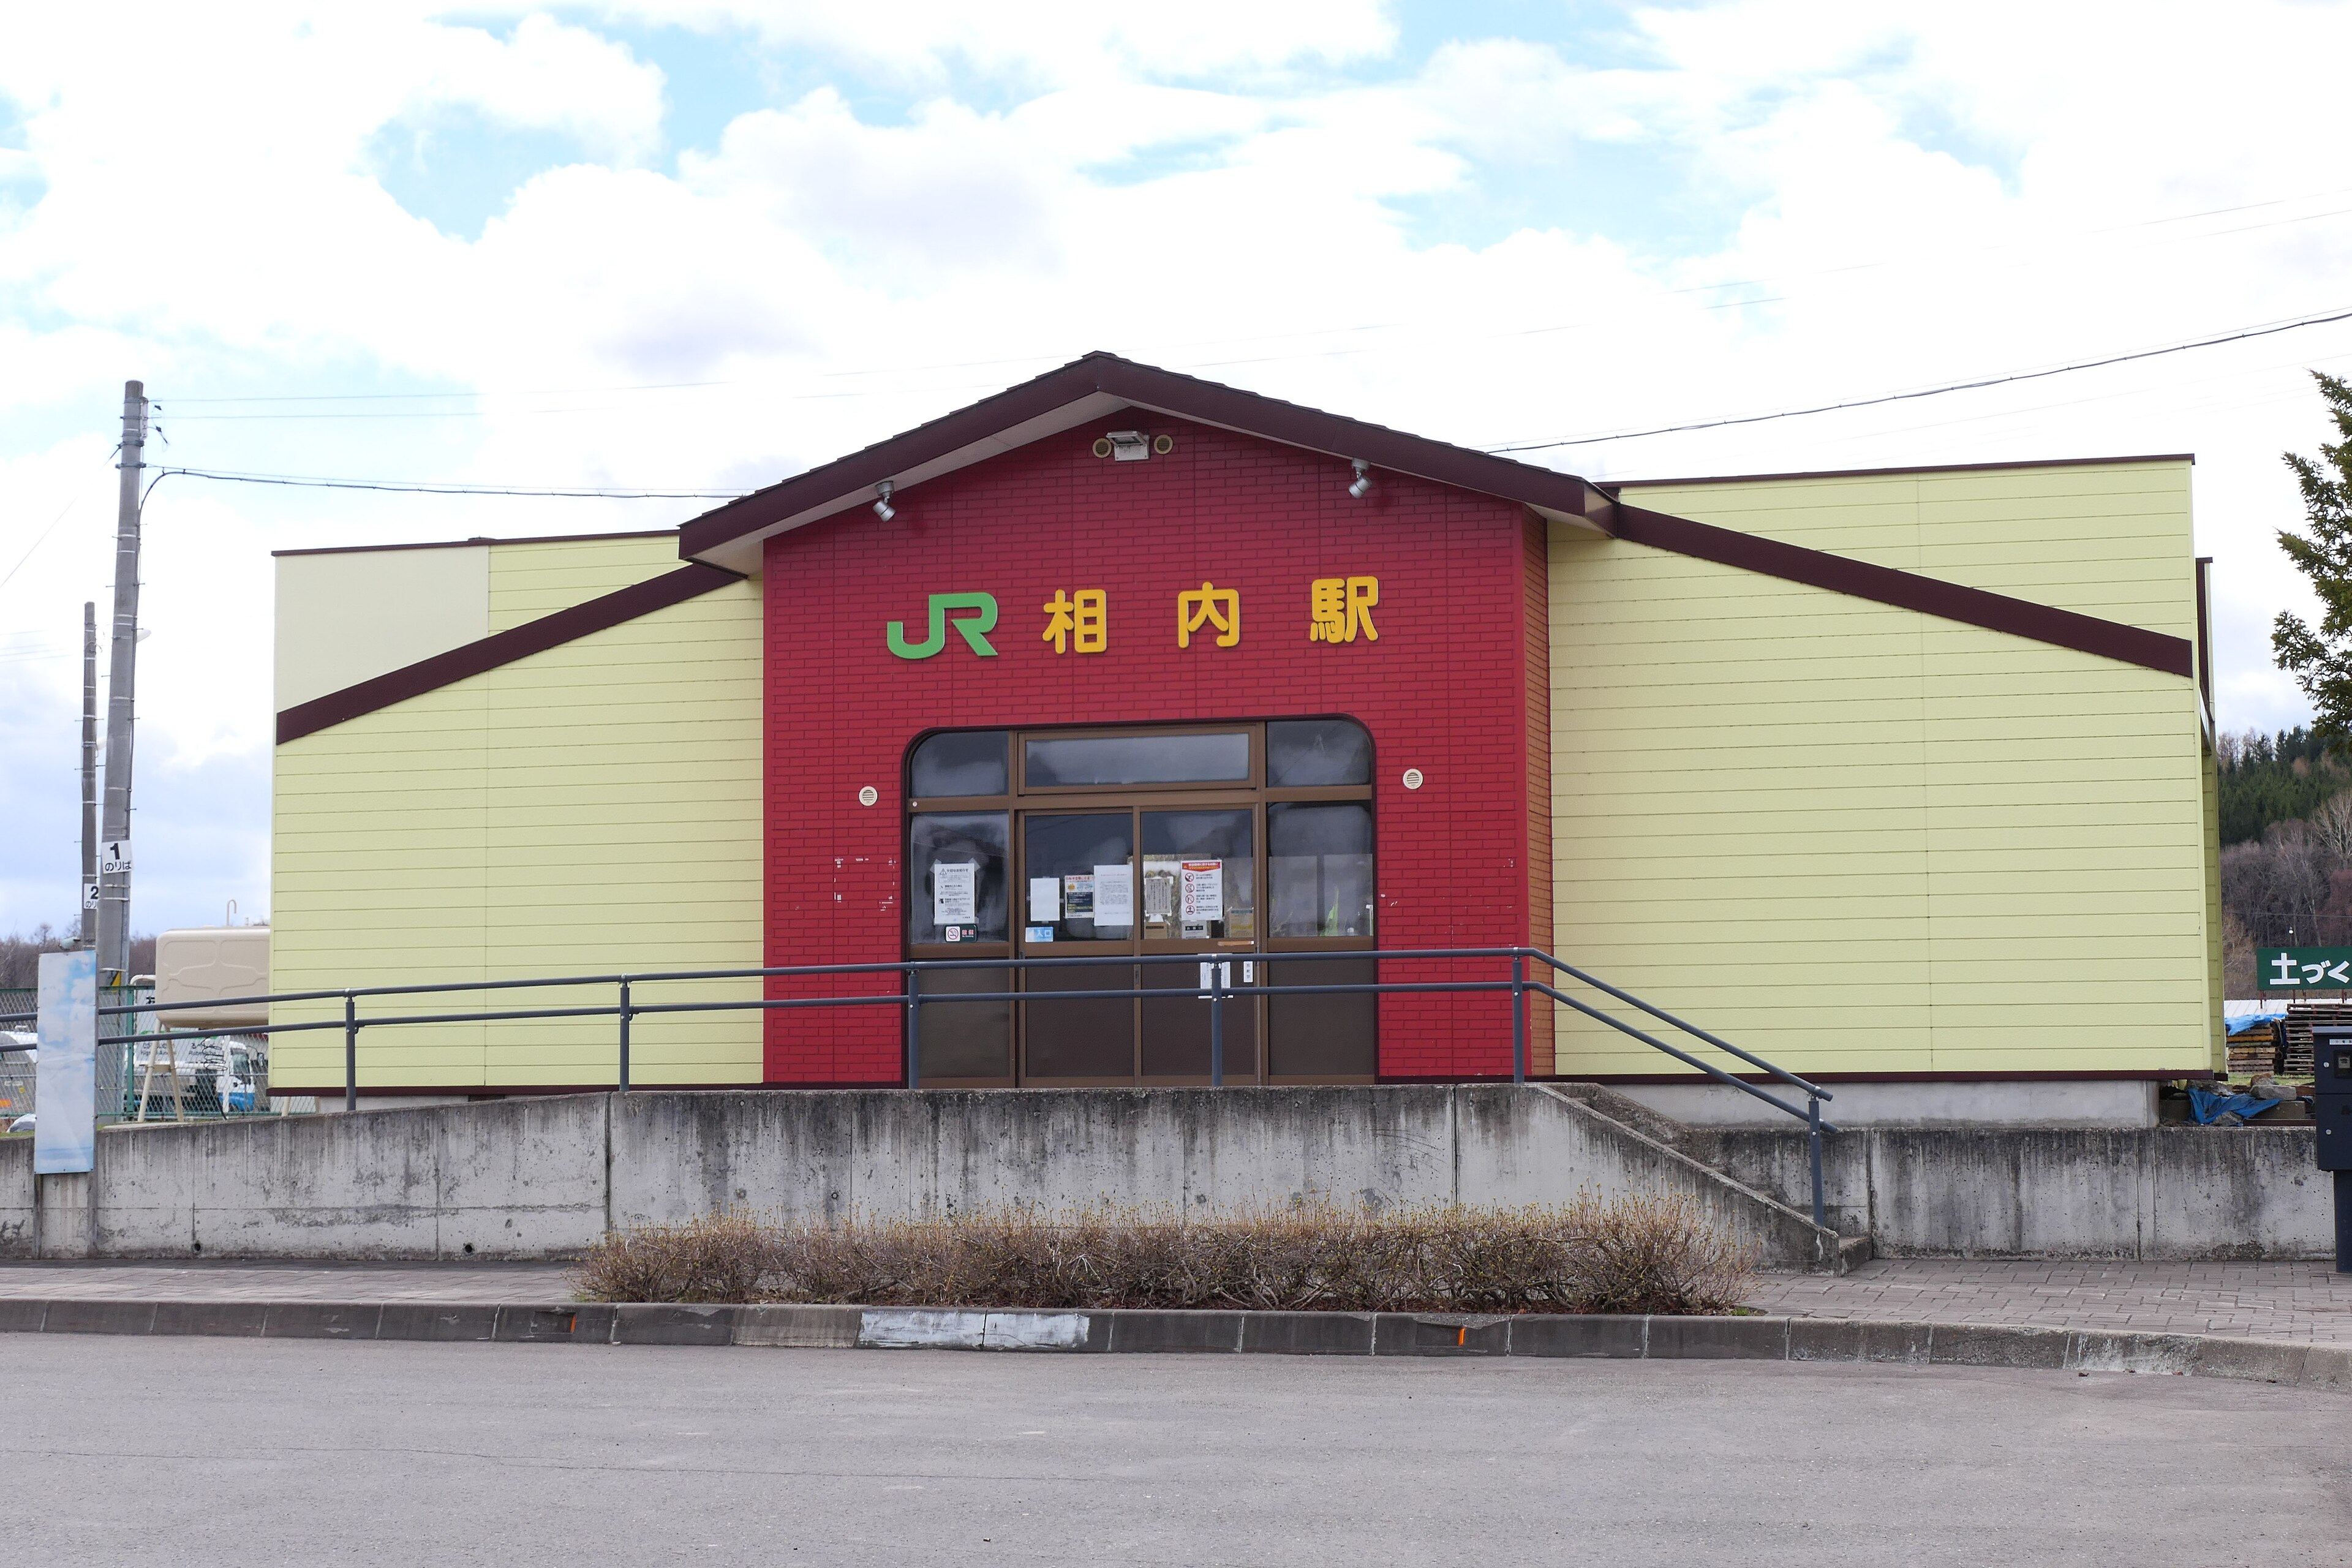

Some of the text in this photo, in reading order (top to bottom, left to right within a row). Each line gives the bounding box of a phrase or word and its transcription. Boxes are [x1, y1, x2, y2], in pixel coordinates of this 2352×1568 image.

[886, 576, 1380, 660] JR 相内駅
[110, 842, 121, 860] 1
[105, 860, 132, 872] のりば
[90, 886, 99, 900] 2
[2269, 952, 2350, 985] 土づく
